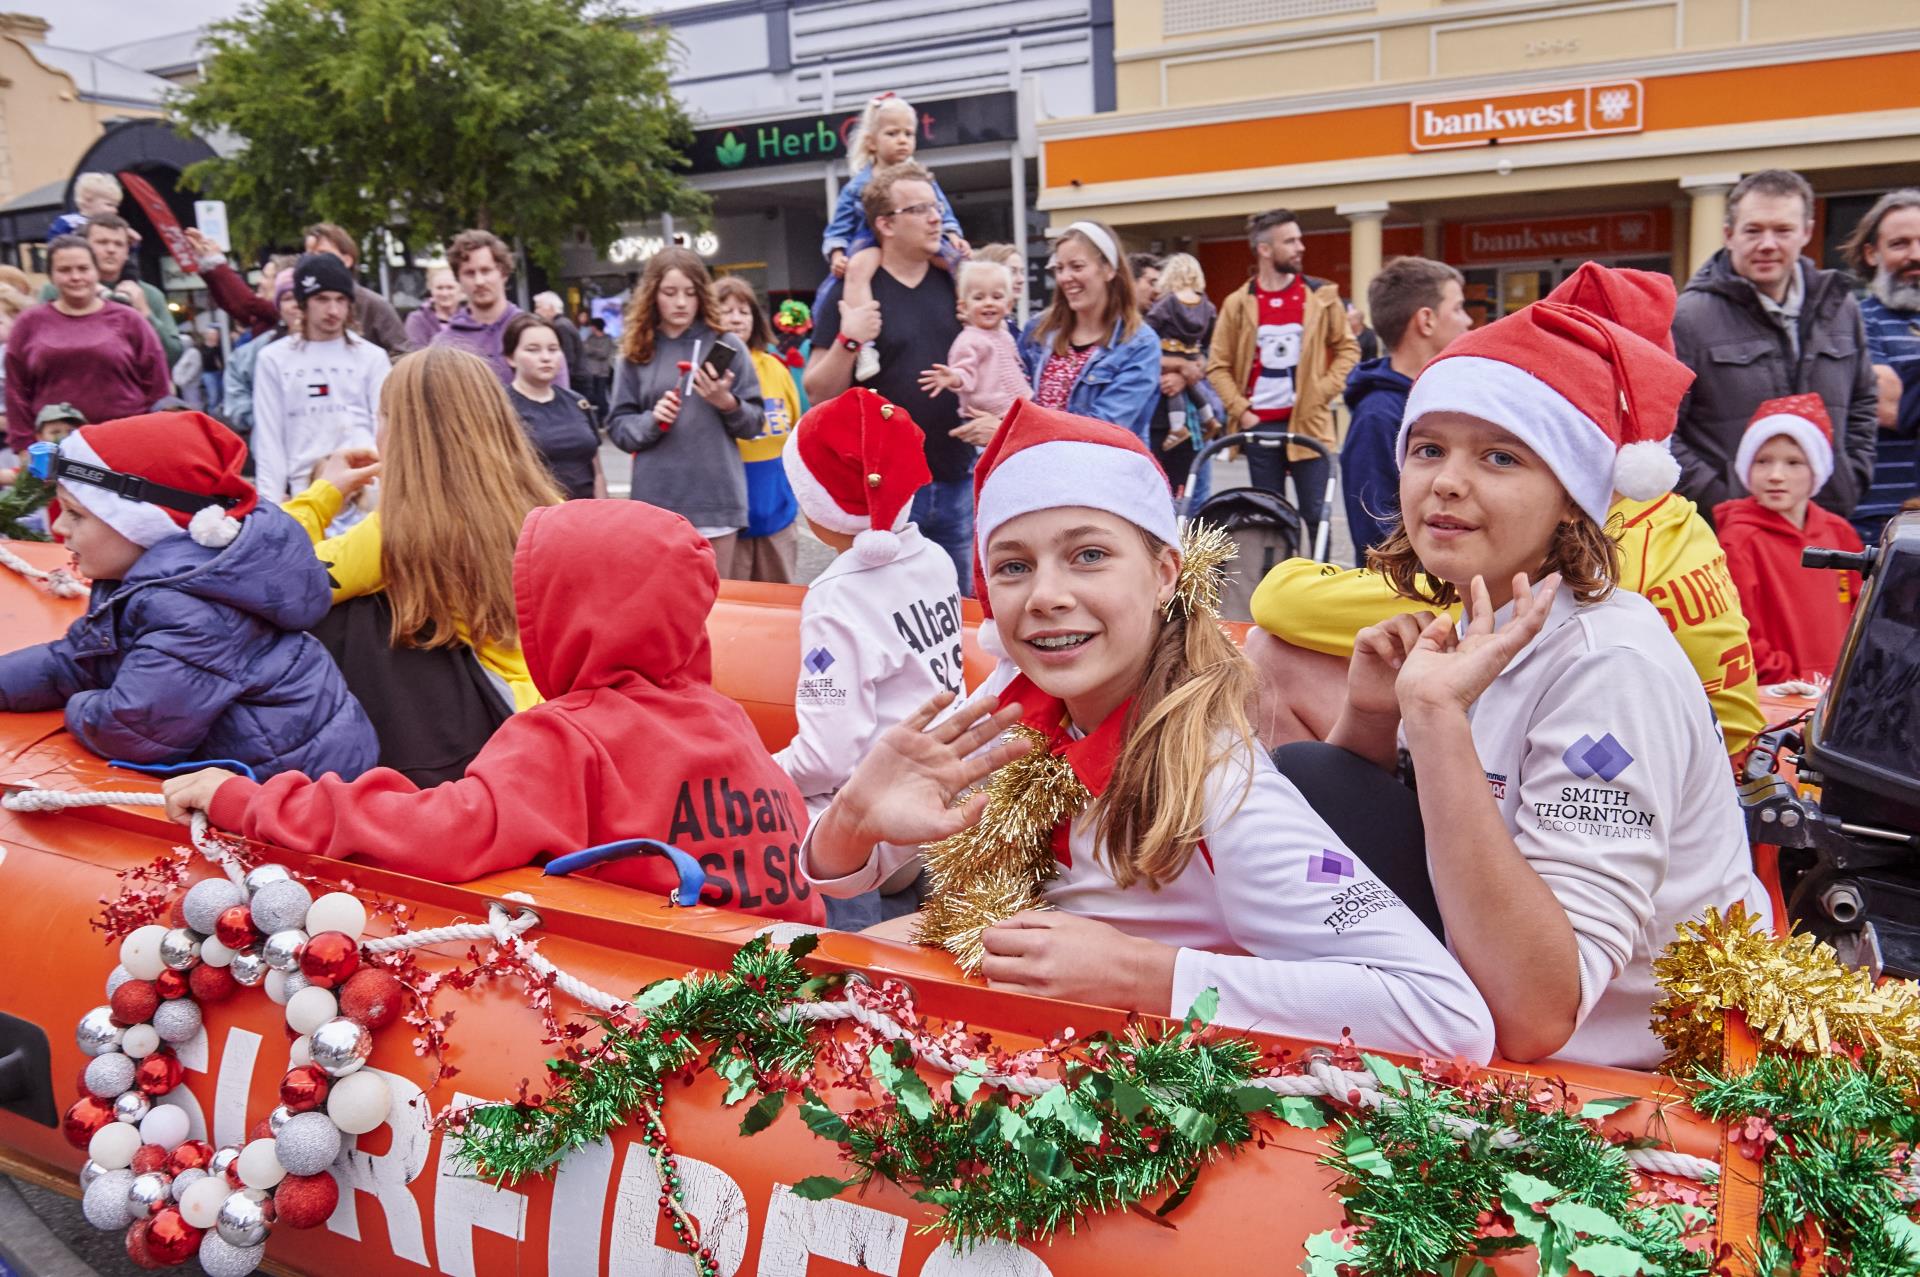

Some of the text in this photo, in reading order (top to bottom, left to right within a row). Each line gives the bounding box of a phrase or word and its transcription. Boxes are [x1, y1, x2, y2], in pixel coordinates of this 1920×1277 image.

[1423, 97, 1577, 137] bankwest
[1471, 223, 1599, 251] bankwest
[892, 591, 961, 654] Alban
[1561, 786, 1630, 806] SMITH
[1534, 802, 1656, 827] THORNTON
[1537, 818, 1652, 839] ACCOUNTANTS
[698, 842, 811, 908] SLSC
[1331, 880, 1381, 904] SMITH
[1323, 889, 1397, 928] THORNTO
